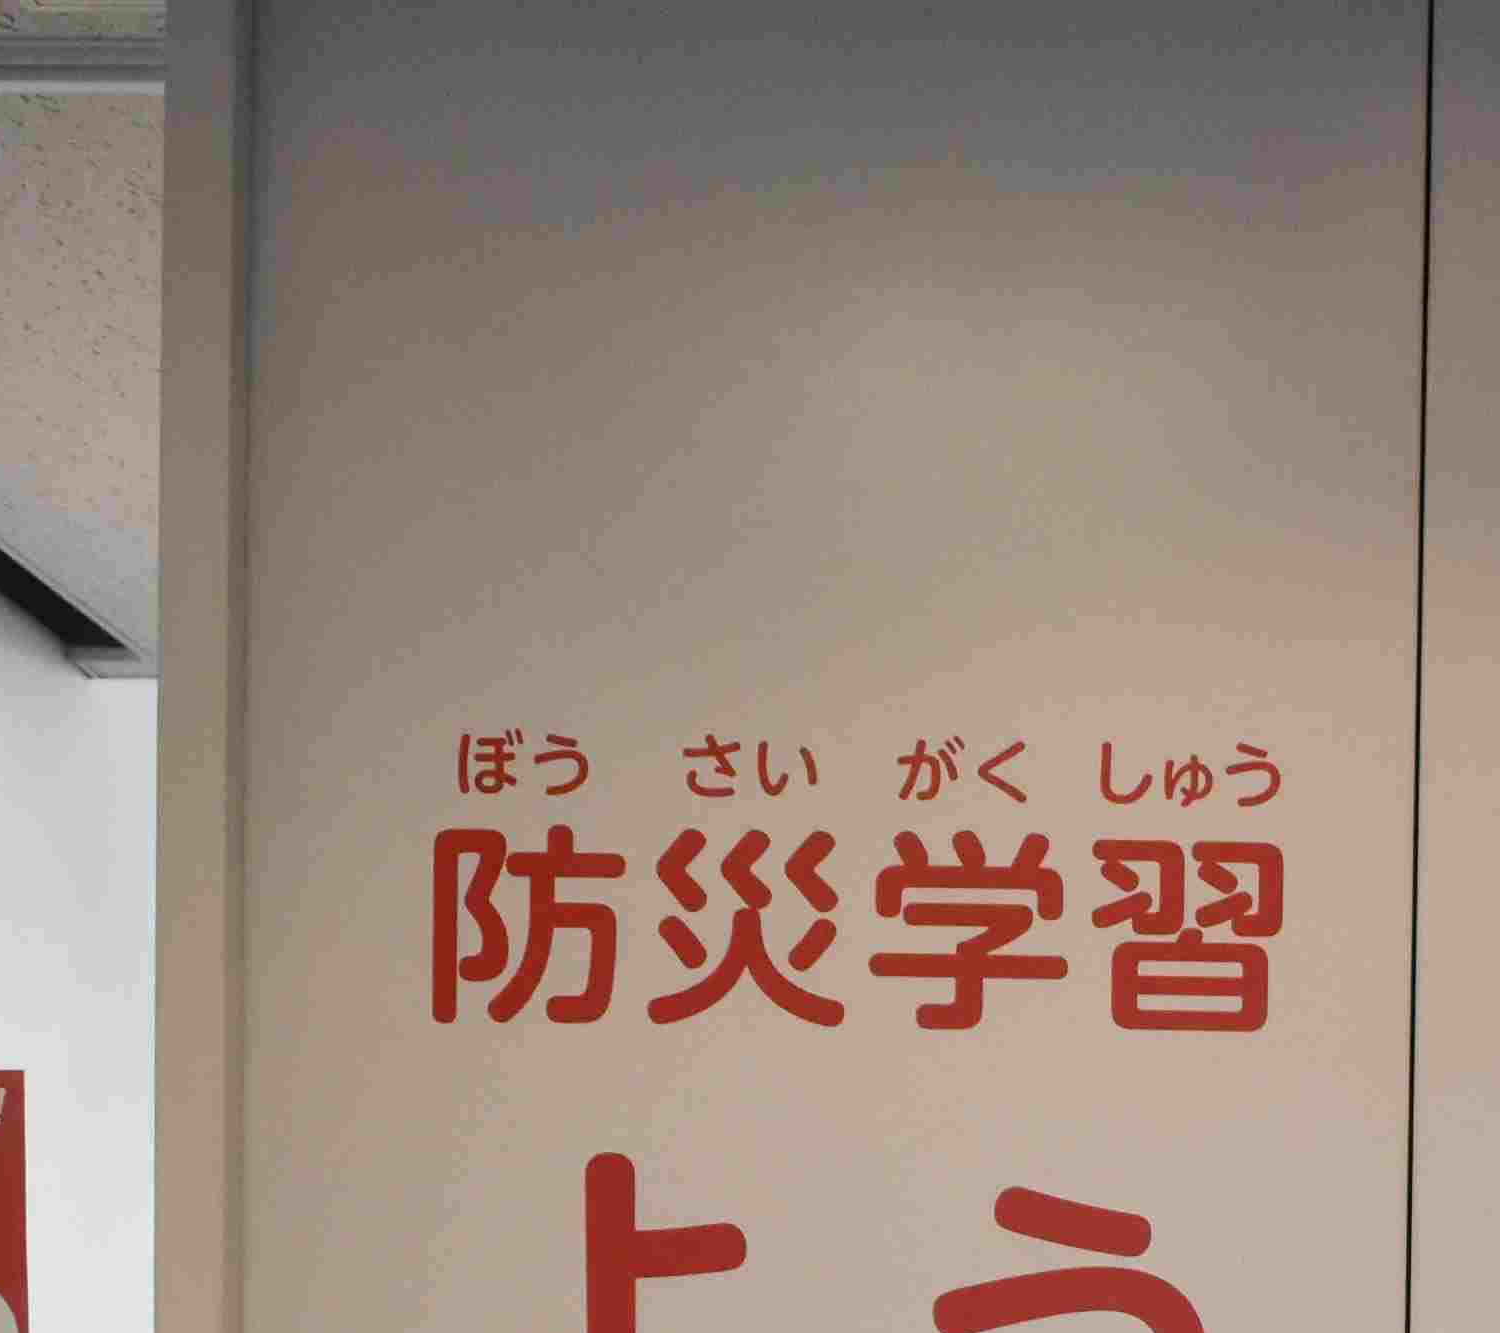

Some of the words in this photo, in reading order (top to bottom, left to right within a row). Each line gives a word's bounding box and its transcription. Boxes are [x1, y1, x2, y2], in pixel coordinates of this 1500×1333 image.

[457, 733, 591, 796] ぼう
[683, 734, 818, 798] さい
[898, 737, 1028, 802] がく
[1098, 742, 1284, 811] しゅう
[432, 824, 1285, 1032] 防災学習
